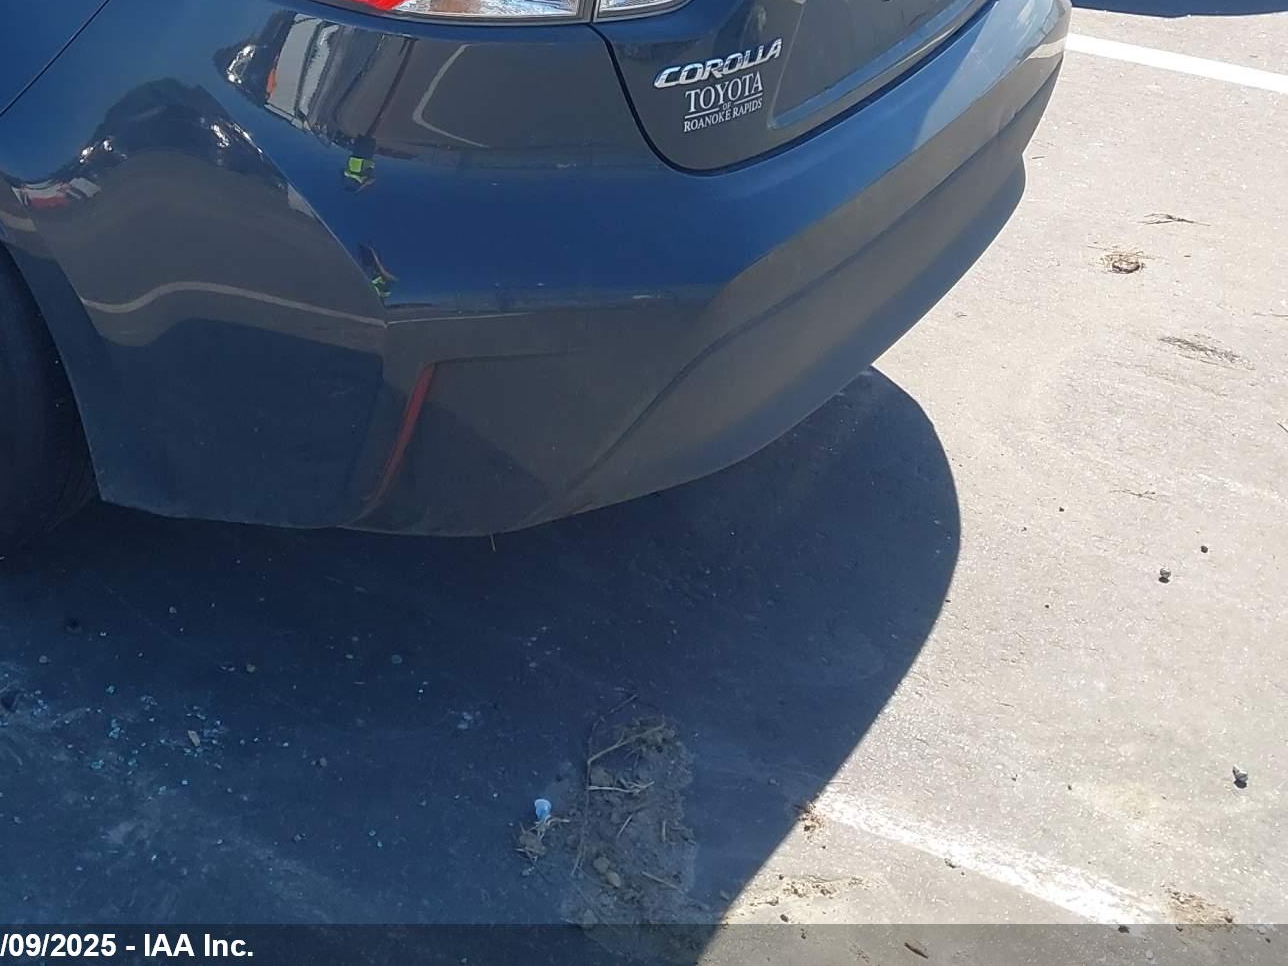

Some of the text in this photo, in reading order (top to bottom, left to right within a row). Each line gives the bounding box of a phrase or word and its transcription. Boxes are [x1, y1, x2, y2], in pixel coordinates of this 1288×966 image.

[654, 38, 782, 88] COROLLA
[685, 71, 763, 112] TOYOTA
[722, 101, 732, 111] OF
[684, 98, 763, 132] ROANOKE RAPIDS
